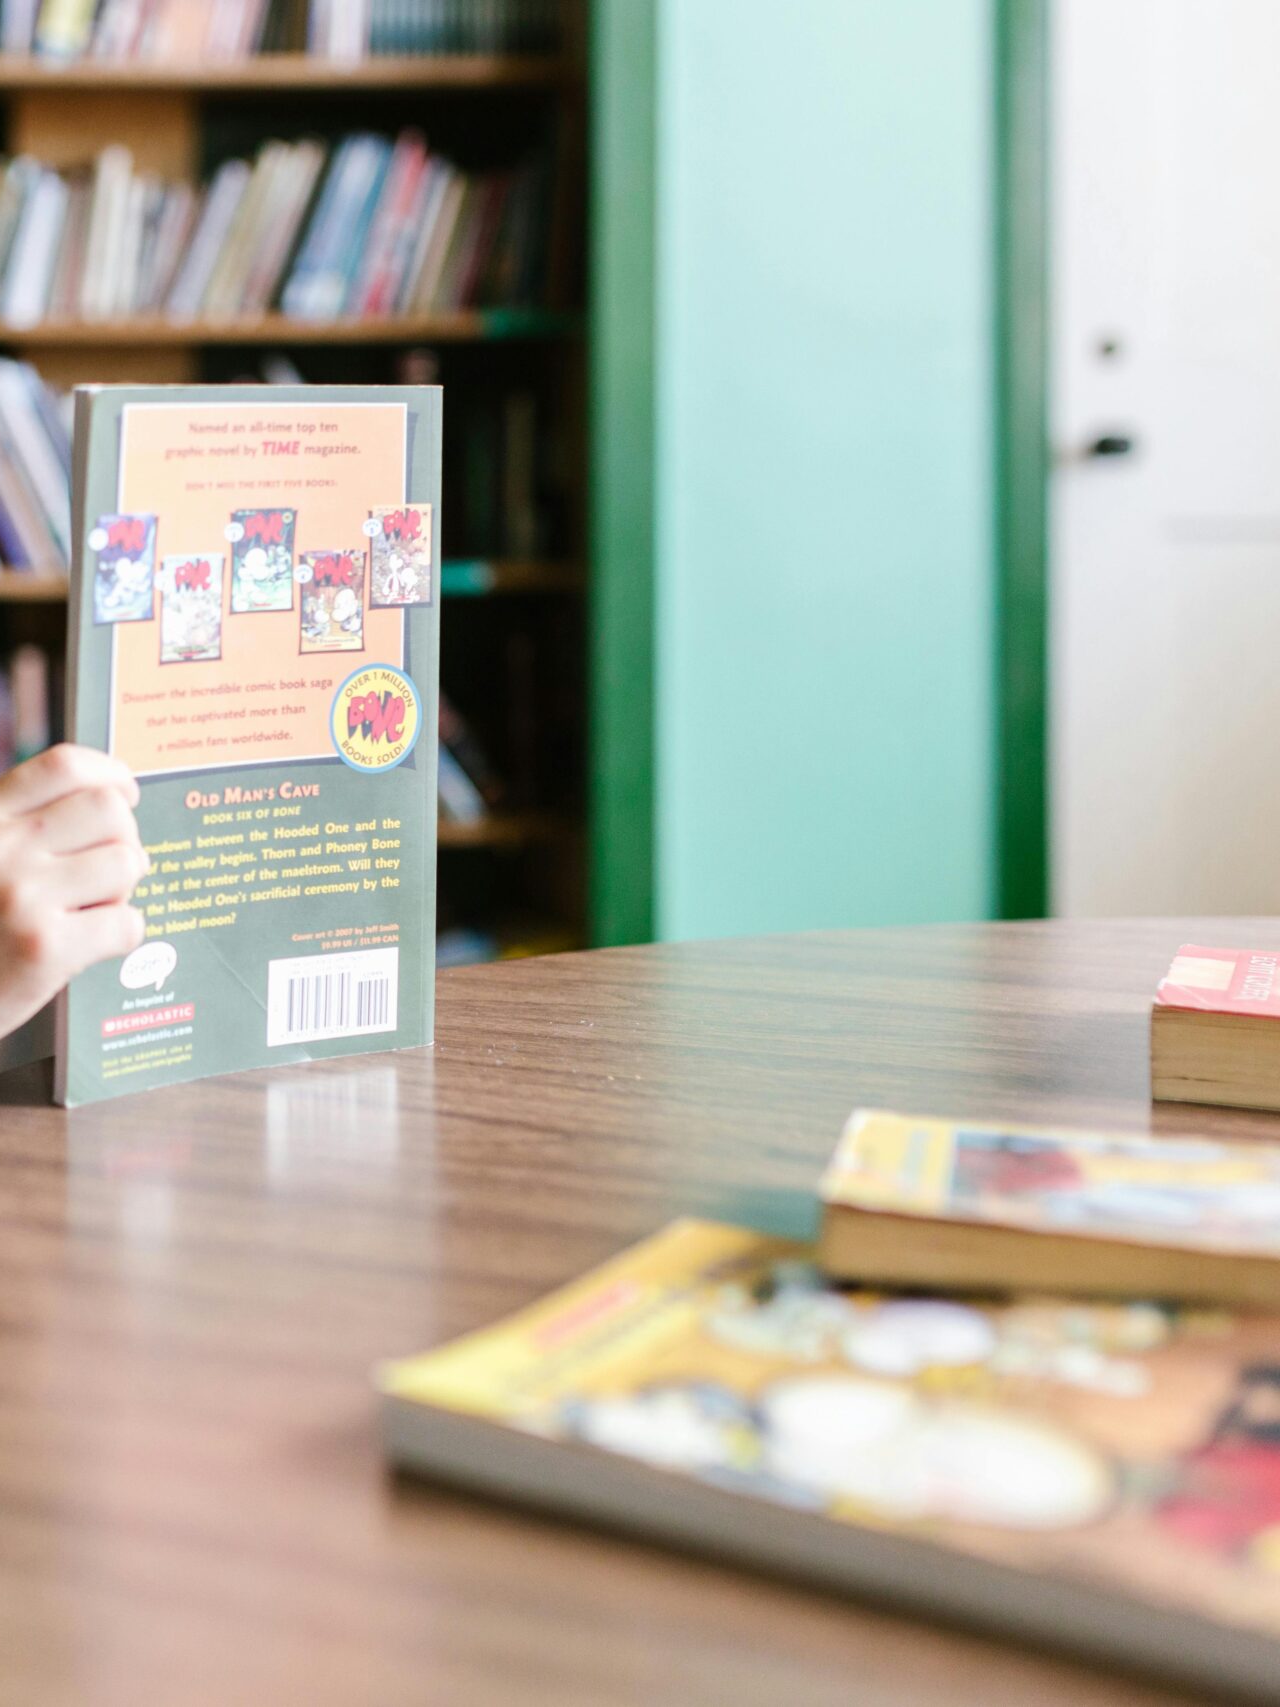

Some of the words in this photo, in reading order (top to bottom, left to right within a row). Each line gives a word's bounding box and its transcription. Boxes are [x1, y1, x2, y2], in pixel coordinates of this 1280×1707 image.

[189, 422, 228, 433] Named
[232, 425, 245, 433] an
[249, 421, 293, 433] all-time
[297, 422, 316, 435] top
[319, 422, 338, 433] ten
[165, 445, 203, 460] graphic
[209, 444, 239, 456] novel
[243, 444, 257, 458] by
[261, 441, 300, 456] TIME
[304, 444, 361, 458] magazine.
[123, 691, 166, 704] Discover
[170, 688, 185, 698] the
[190, 683, 241, 698] incredible
[245, 681, 275, 692] comic
[279, 678, 306, 689] book
[310, 678, 333, 690] saga
[345, 674, 371, 698] OVER
[381, 672, 414, 708] MILLION
[146, 716, 167, 727] that
[171, 715, 186, 724] has
[191, 709, 245, 724] captivated
[250, 707, 277, 717] more
[281, 705, 305, 714] than
[167, 738, 202, 750] million
[207, 736, 228, 746] fans
[232, 731, 293, 744] worldwide.
[341, 740, 372, 764] BOOKS
[377, 743, 405, 764] SOLD!
[203, 812, 233, 825] BOOK
[237, 810, 252, 822] SIX
[256, 809, 269, 820] OF
[273, 805, 301, 817] BONE
[197, 833, 244, 849] between
[250, 829, 268, 842] the
[274, 824, 319, 840] Hooded
[325, 822, 348, 834] One
[356, 819, 376, 832] and
[382, 818, 401, 829] the
[162, 860, 180, 873] the
[184, 855, 215, 870] valley
[220, 852, 256, 867] begins.
[261, 848, 295, 861] Thorn
[300, 845, 321, 856] and
[326, 840, 367, 857] Phoney
[372, 838, 400, 850] Bone
[135, 884, 148, 898] to
[151, 882, 165, 895] be
[168, 879, 180, 893] at
[183, 877, 201, 890] the
[205, 873, 239, 888] center
[243, 867, 255, 882] of
[260, 867, 277, 880] the
[282, 861, 343, 877] maelstrom.
[348, 858, 370, 871] Will
[375, 857, 400, 871] they
[147, 904, 165, 916] the
[168, 898, 211, 913] Hooded
[215, 893, 247, 906] One's
[251, 886, 300, 901] sacrificial
[305, 881, 359, 897] ceremony
[364, 877, 377, 891] by
[381, 875, 400, 887] the
[146, 924, 163, 937] the
[166, 918, 197, 933] blood
[200, 912, 236, 928] moon?
[116, 1007, 192, 1030] SCHOLASTIC
